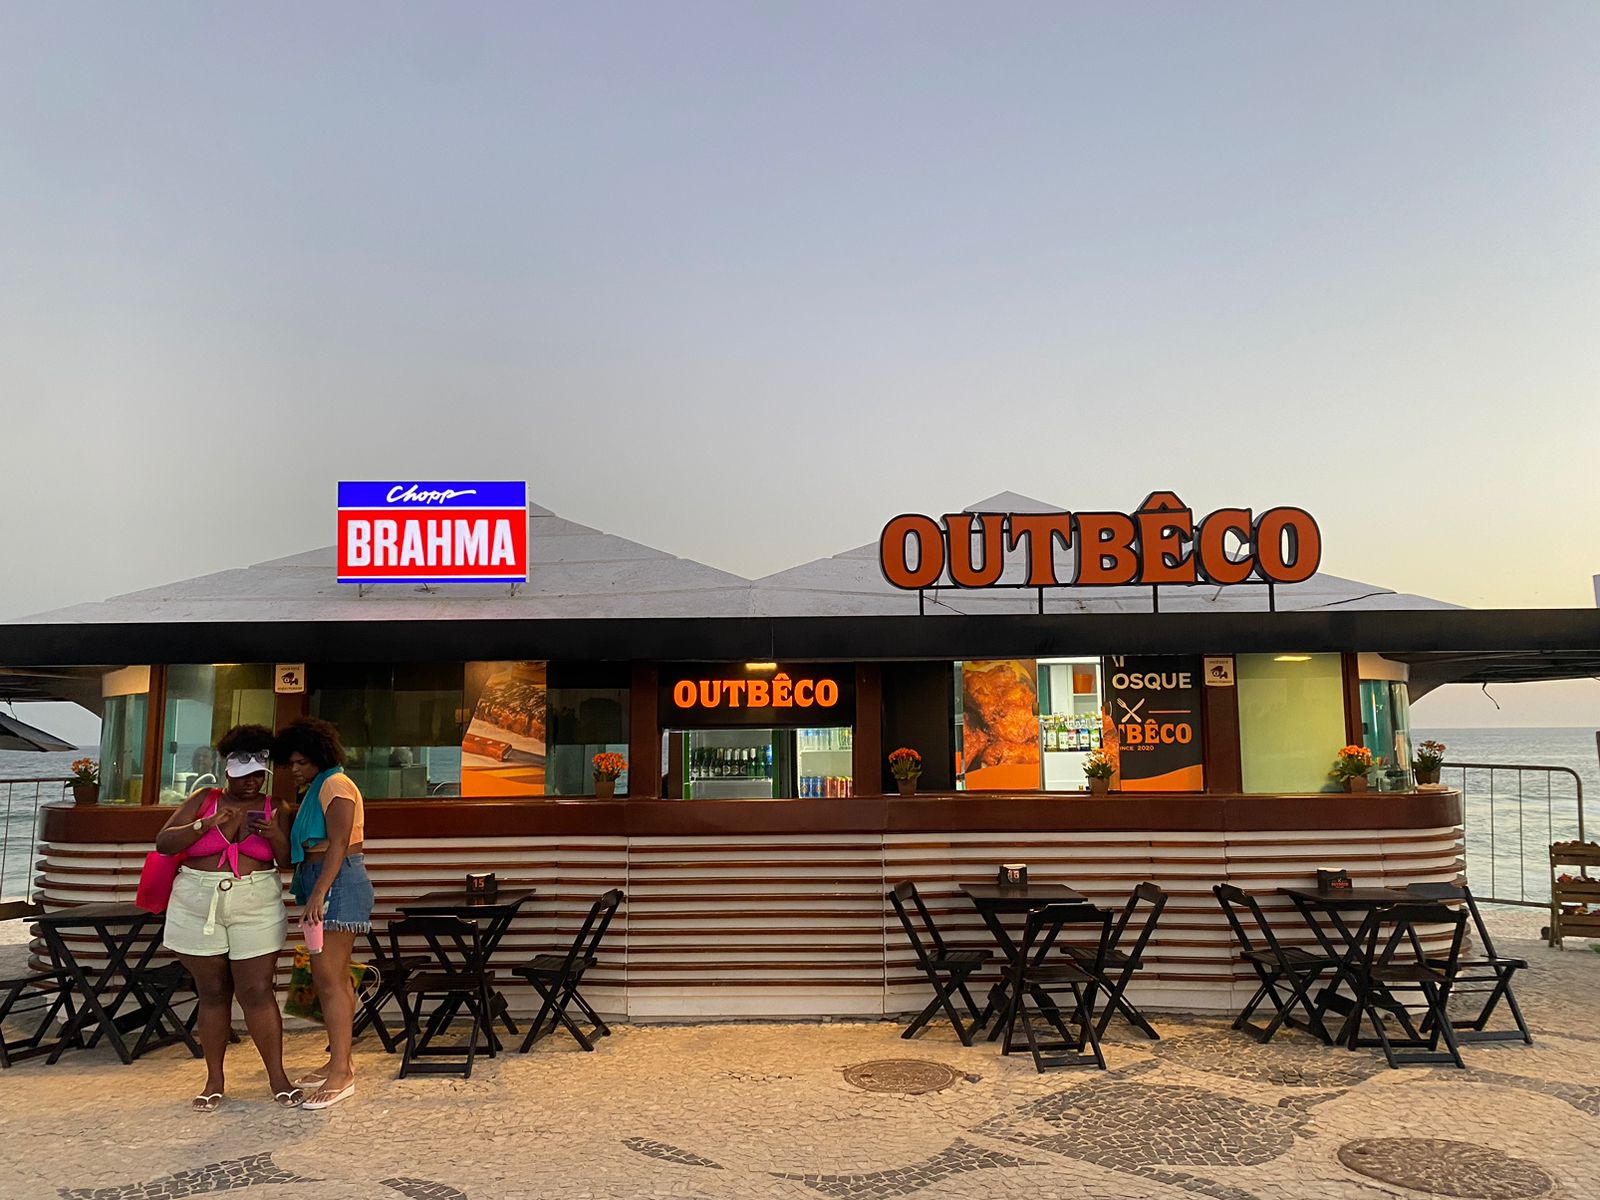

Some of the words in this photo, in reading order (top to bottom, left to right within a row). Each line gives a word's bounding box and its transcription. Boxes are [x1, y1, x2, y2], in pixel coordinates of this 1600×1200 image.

[387, 485, 476, 504] Chopp
[347, 519, 515, 566] BRAHMA
[880, 491, 1322, 589] OUTBÊCO
[673, 673, 839, 708] OUTBÊCO
[1112, 673, 1192, 690] OSQUE
[472, 878, 485, 888] 15
